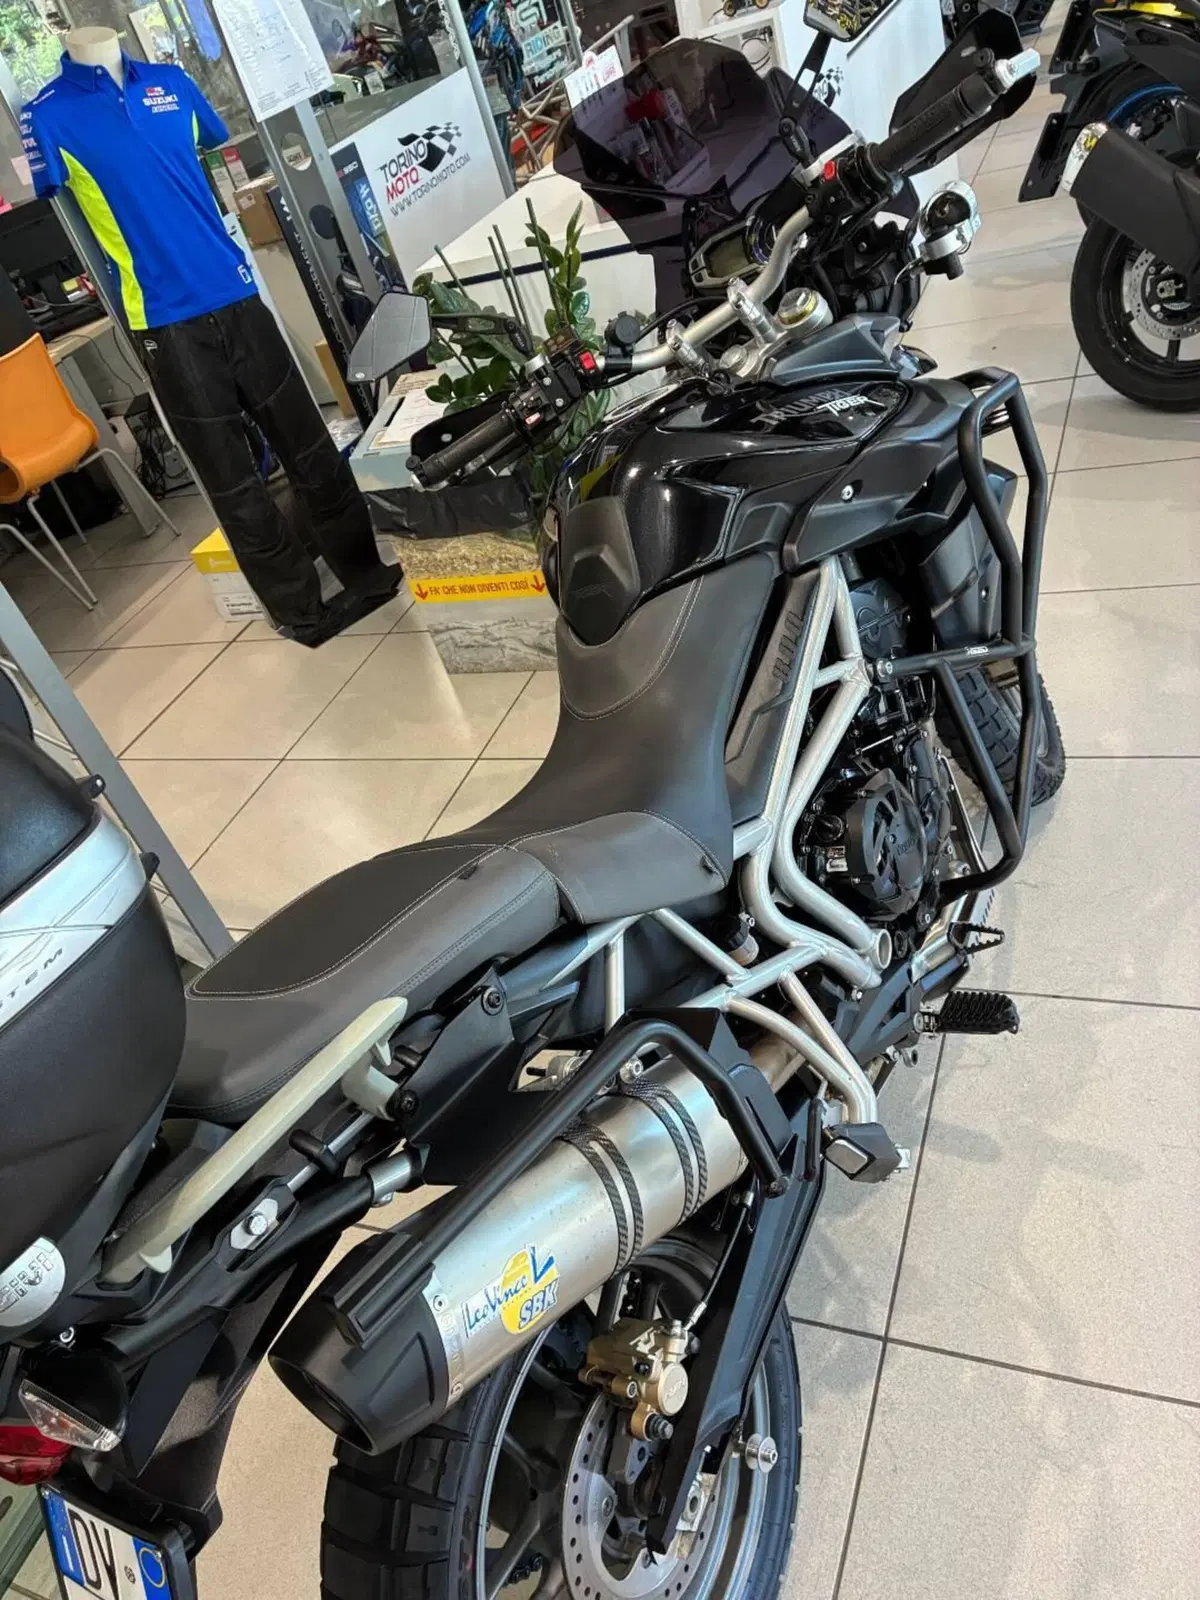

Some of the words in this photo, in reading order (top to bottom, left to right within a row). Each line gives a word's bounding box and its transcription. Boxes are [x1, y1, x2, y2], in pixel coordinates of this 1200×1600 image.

[524, 26, 563, 58] RIDING
[142, 94, 179, 106] SUZUKI
[376, 138, 427, 184] TORINO
[385, 165, 421, 204] MOTO
[389, 152, 471, 218] WWW.TORINOMOTO.COM
[750, 388, 852, 426] TRIUMPH
[814, 393, 888, 417] TIGER
[442, 584, 460, 596] CHE
[459, 583, 477, 595] NON
[477, 581, 510, 594] DIVENTI
[462, 1274, 529, 1331] LeoVince
[518, 1279, 559, 1330] SBK
[68, 1508, 120, 1600] DV
